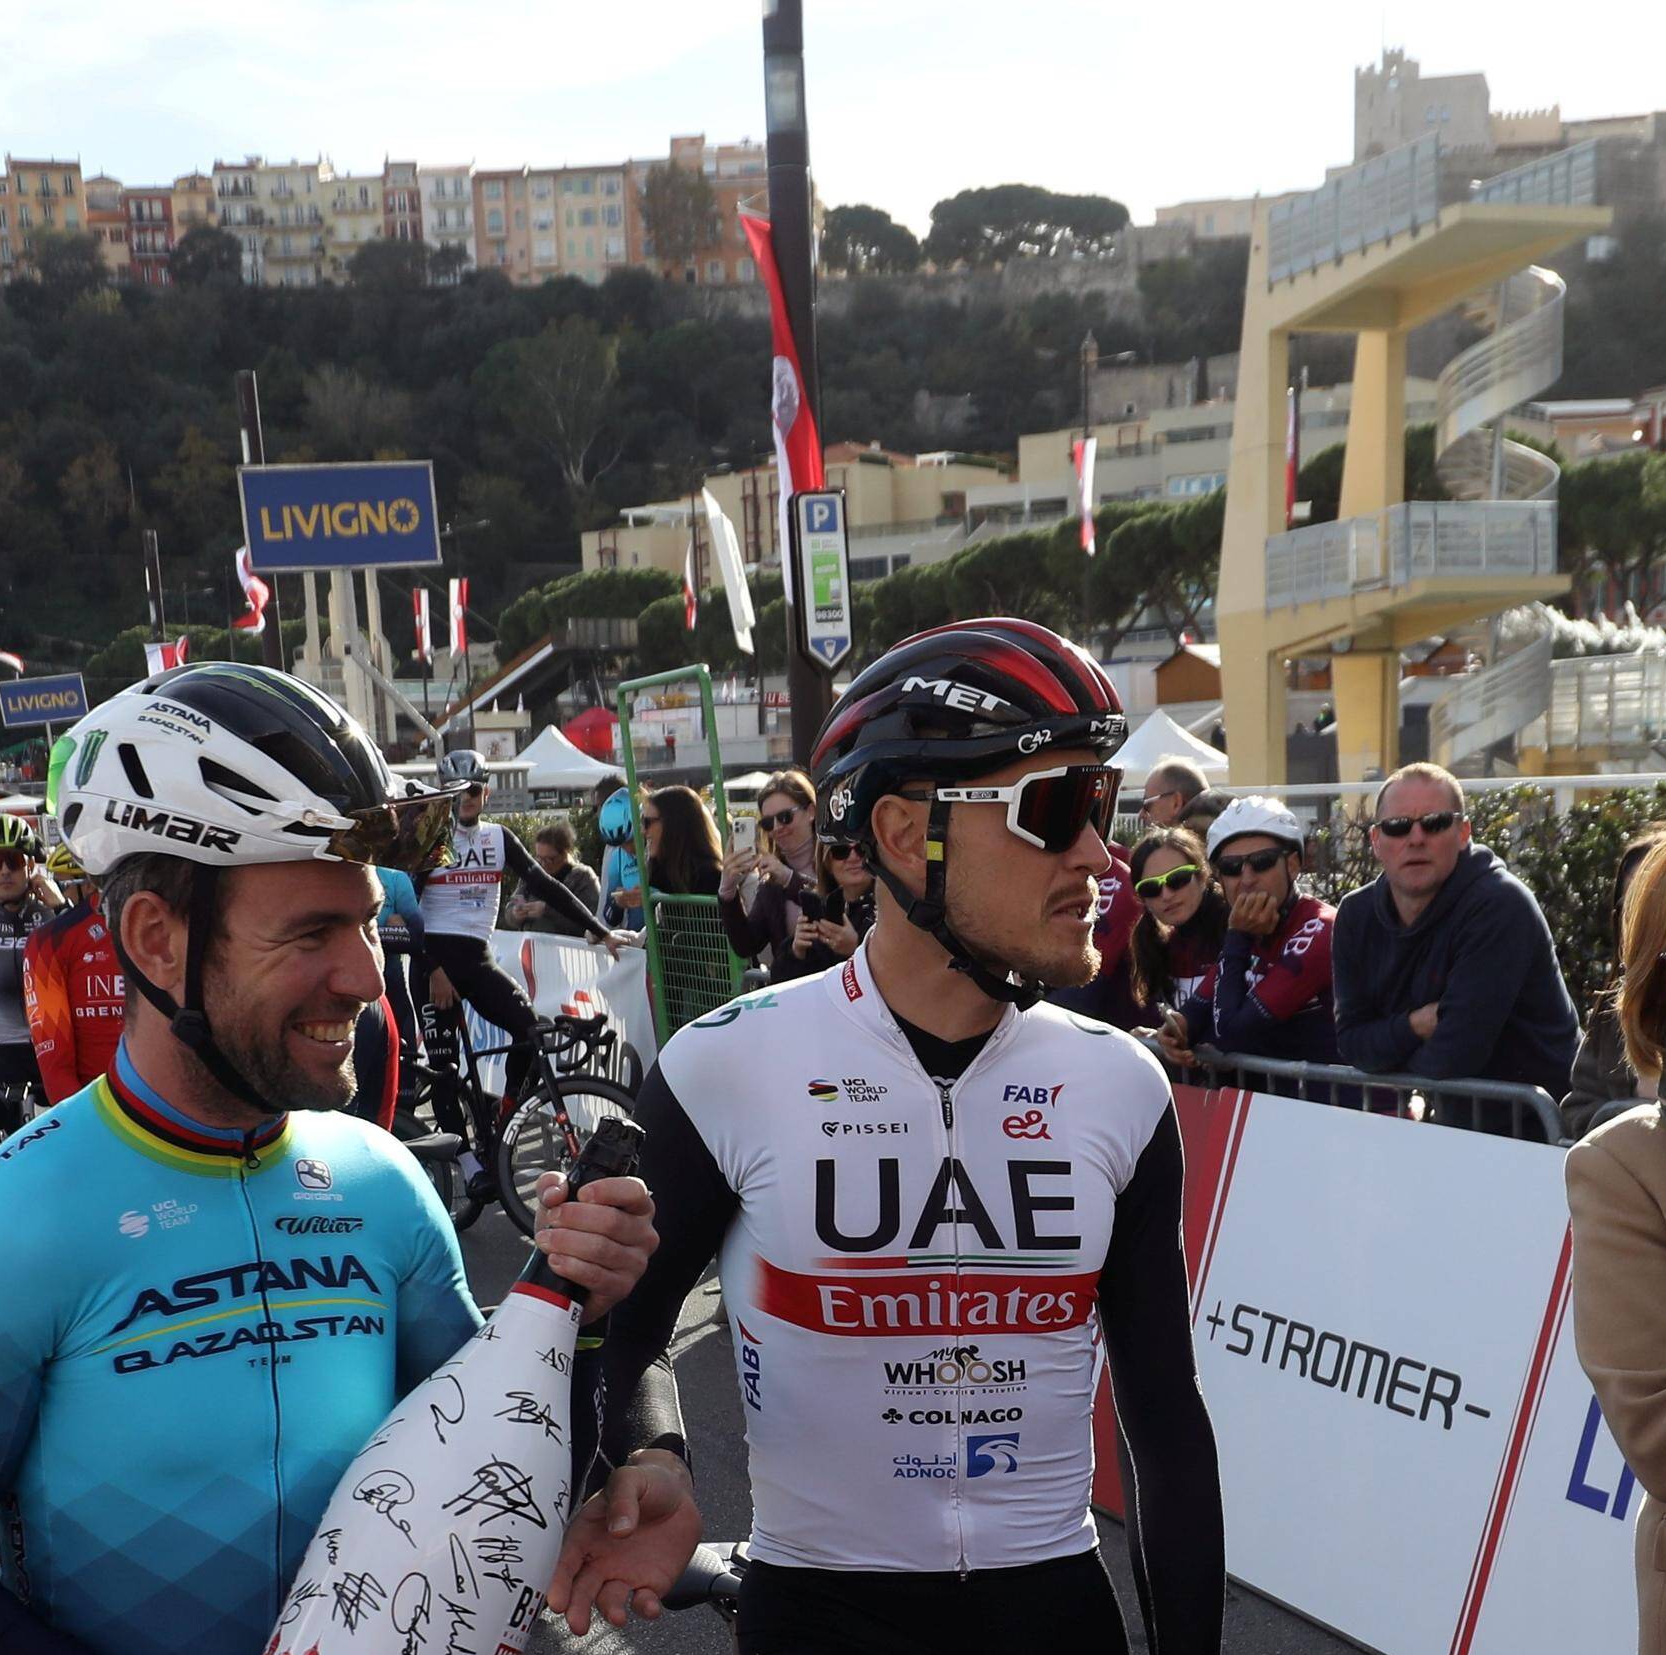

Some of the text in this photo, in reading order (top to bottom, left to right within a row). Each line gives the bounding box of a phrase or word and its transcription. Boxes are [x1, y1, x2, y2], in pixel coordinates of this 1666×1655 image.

[260, 495, 421, 541] LIVIGNO
[813, 503, 830, 530] P
[815, 609, 844, 620] 98300
[7, 690, 79, 713] LIVIGNO
[901, 676, 1011, 712] MET
[146, 702, 211, 734] ASTANA
[1090, 719, 1126, 735] MET
[445, 871, 497, 883] Emirates
[842, 1078, 866, 1087] UCI
[845, 1086, 888, 1095] WORLD
[849, 1094, 880, 1102] TEAM
[844, 1122, 909, 1135] PISSEI
[1002, 1110, 1053, 1140] e&
[152, 1199, 178, 1212] UCI
[155, 1203, 198, 1221] WORLD
[815, 1156, 1082, 1252] UAE
[159, 1214, 191, 1230] TEAM
[275, 1215, 364, 1236] Wilier
[107, 1254, 383, 1337] ASTANA
[816, 1280, 1077, 1329] Emirates
[113, 1316, 384, 1376] QAZAQSTAN
[884, 1359, 1027, 1386] WHOOSH
[884, 1385, 1028, 1397] Virtual Cycing Solution
[908, 1407, 1024, 1426] COLNAGO
[893, 1452, 958, 1468] أدنوك
[893, 1468, 958, 1480] ADNOC
